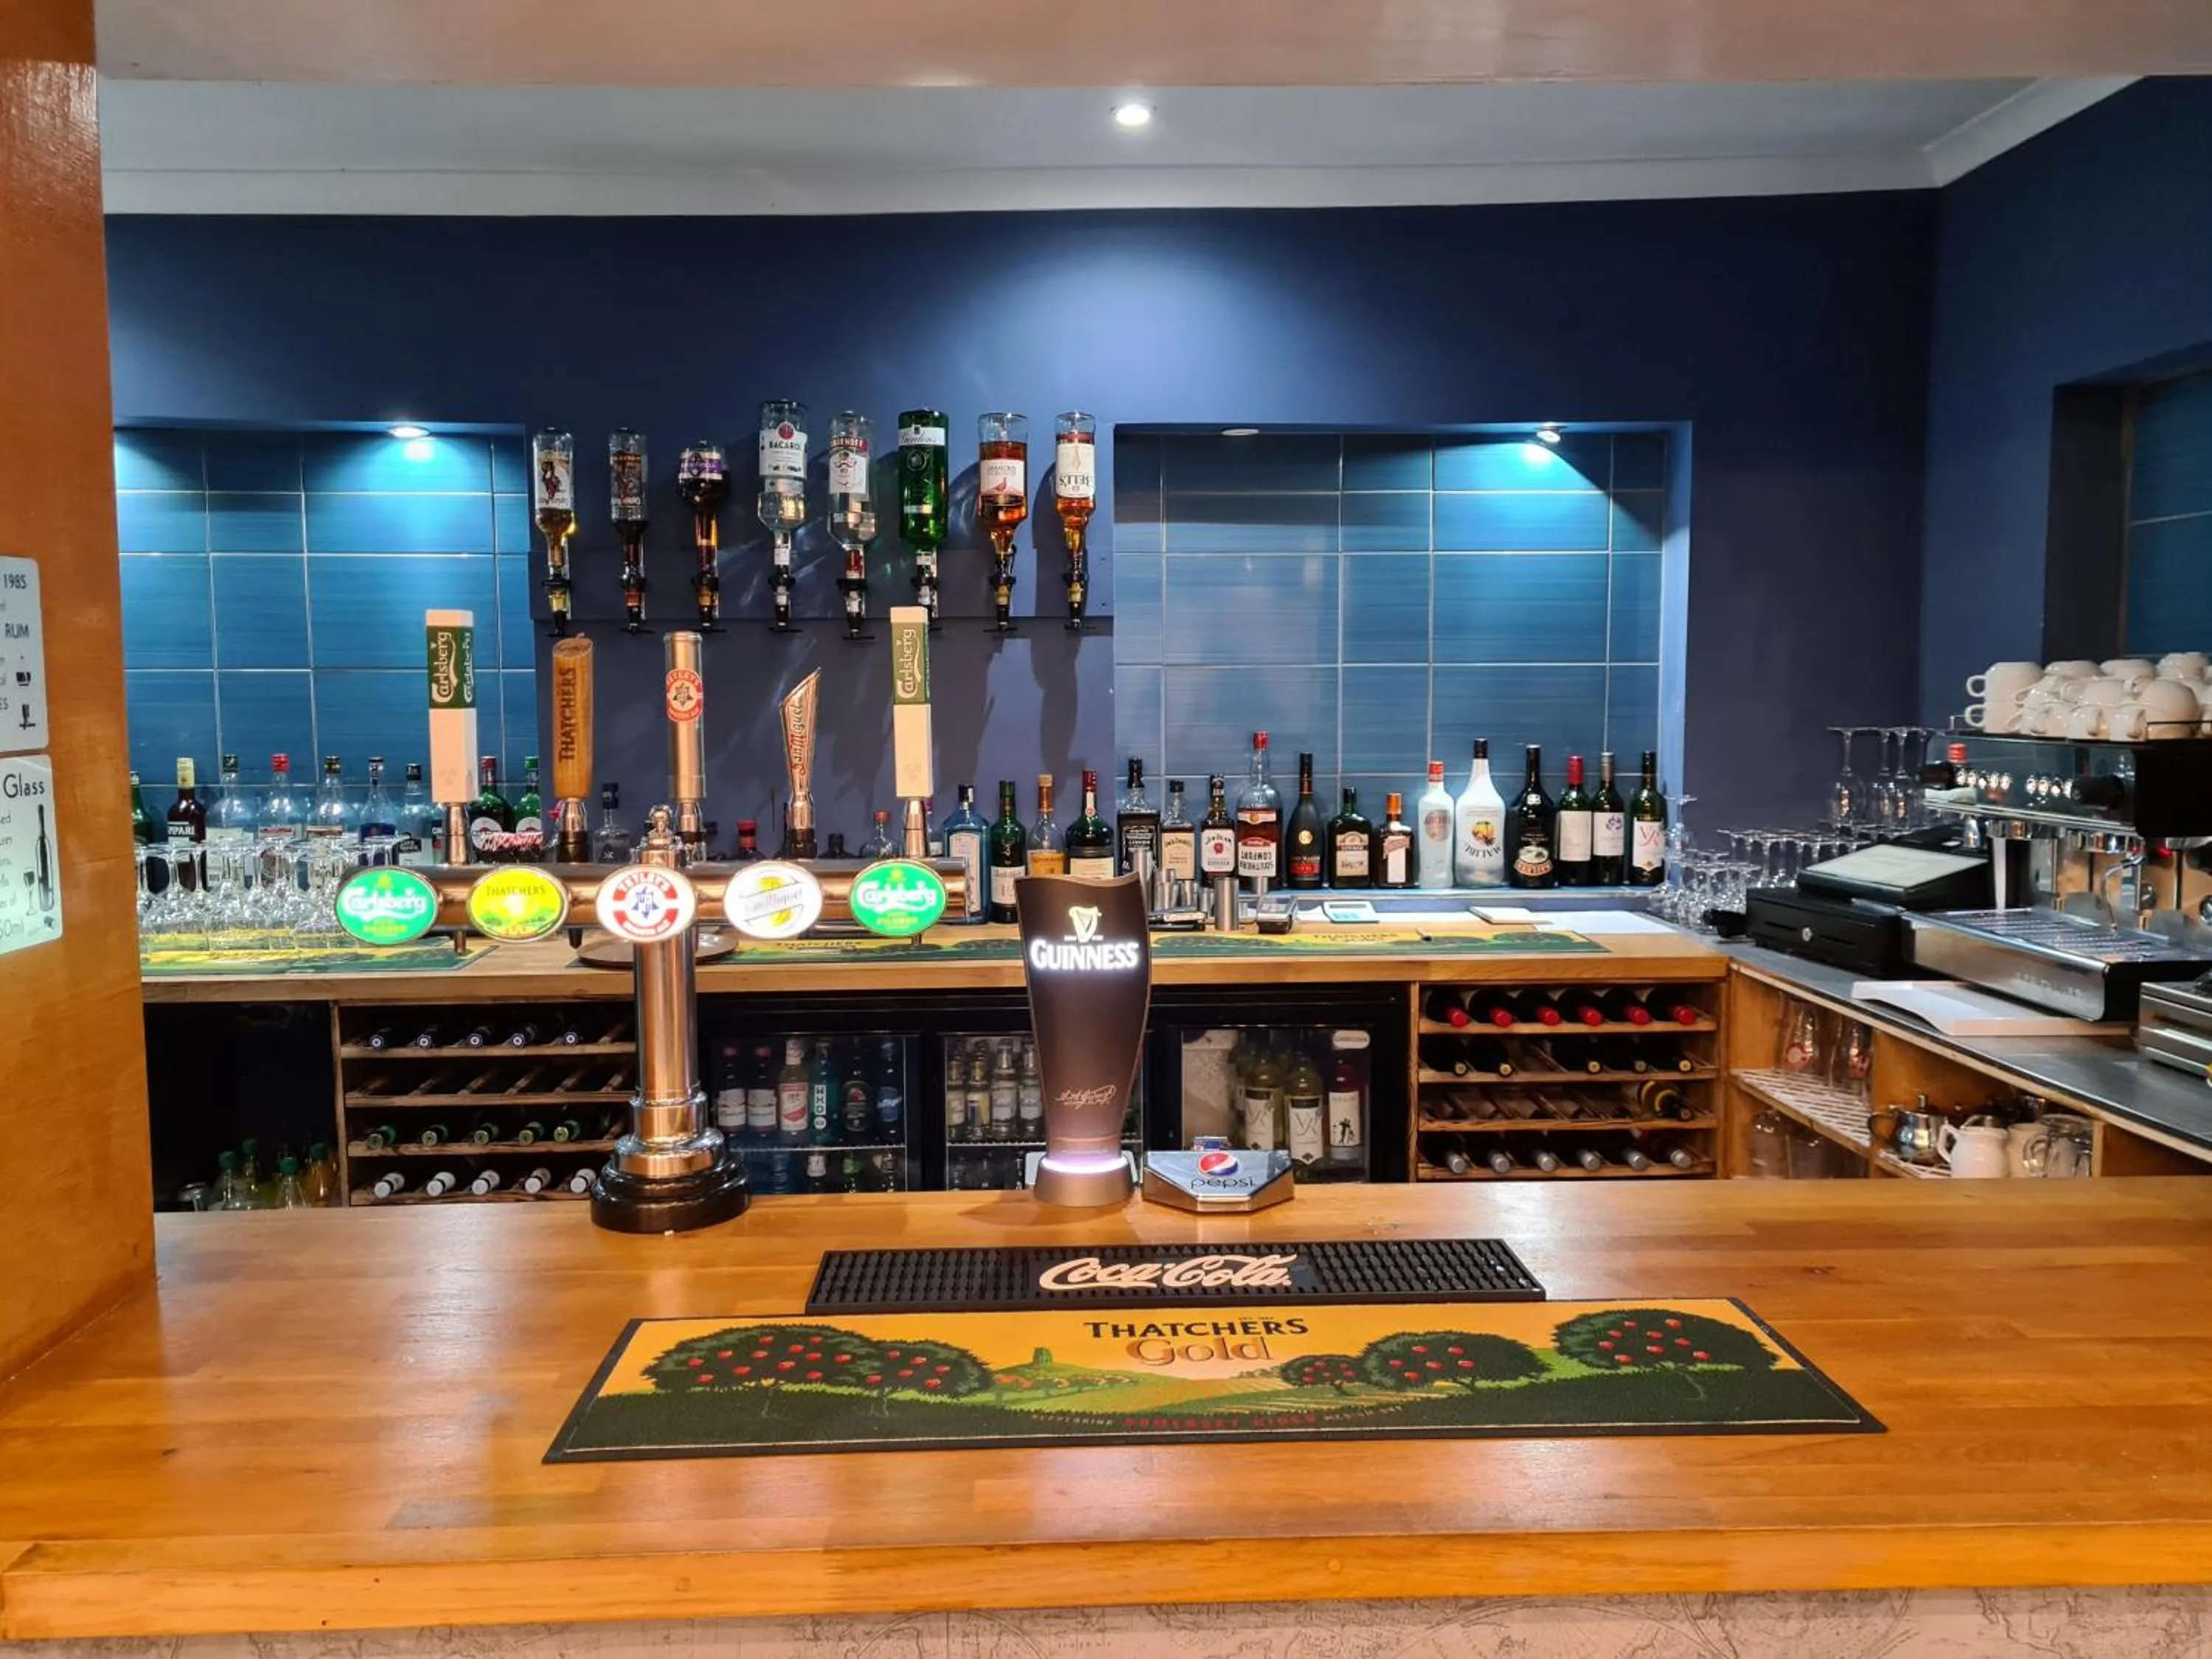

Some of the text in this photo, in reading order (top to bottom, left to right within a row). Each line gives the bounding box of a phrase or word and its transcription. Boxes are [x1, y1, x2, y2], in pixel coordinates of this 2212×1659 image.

[5, 624, 29, 639] RUM
[431, 632, 457, 702] Carlsberg
[896, 628, 922, 698] Carlsberg
[559, 667, 577, 762] THATCHERS
[3, 773, 45, 798] Glass
[486, 885, 546, 897] THATCHERS
[857, 880, 936, 913] Carlsberg
[1031, 939, 1139, 970] GUINNESS
[1191, 1178, 1255, 1189] pepsi
[1040, 1254, 1297, 1290] Coca-Cola
[1084, 1318, 1309, 1339] THATCHERS
[1127, 1336, 1274, 1366] Gold
